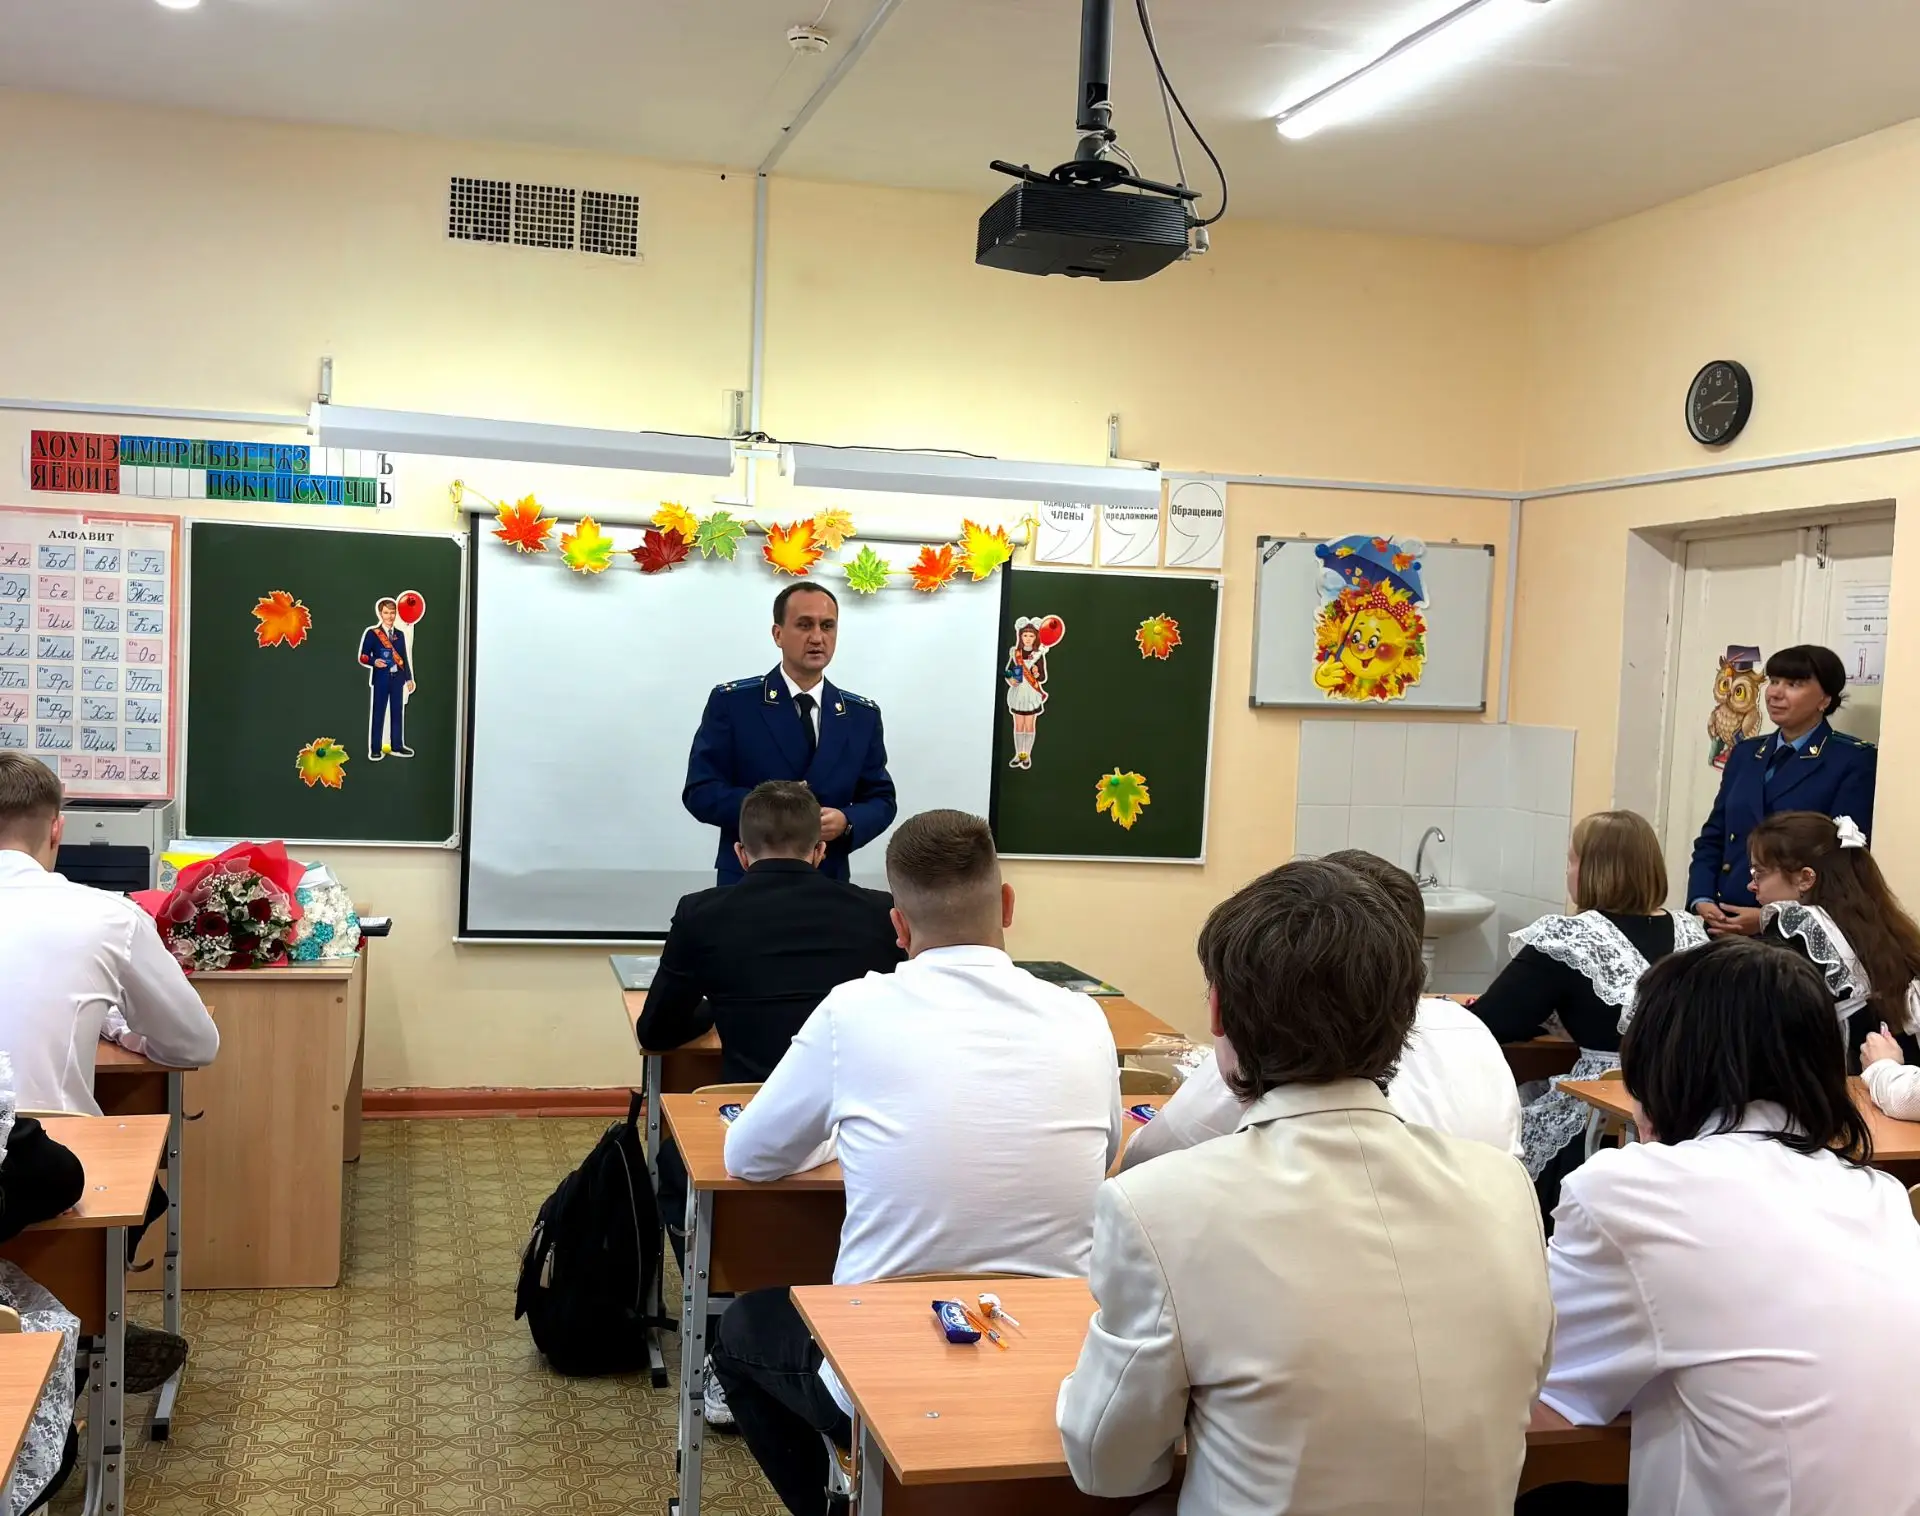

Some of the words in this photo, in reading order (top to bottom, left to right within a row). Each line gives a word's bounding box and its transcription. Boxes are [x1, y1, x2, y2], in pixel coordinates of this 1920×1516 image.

[1050, 510, 1084, 520] члены
[1106, 511, 1158, 521] предложение
[1171, 504, 1222, 518] Обращение
[48, 530, 114, 542] АЛФАВИТ
[2, 552, 29, 566] Аа
[45, 552, 75, 568] Бб
[95, 555, 118, 570] Вв
[140, 557, 161, 572] Гг
[2, 581, 27, 602] Дд
[50, 583, 68, 598] Ее
[128, 587, 164, 603] Жж
[48, 613, 72, 628] Ии
[134, 617, 161, 632] Кк
[38, 644, 73, 658] Мм
[91, 645, 118, 660] Нн
[139, 647, 156, 662] Оо
[0, 671, 26, 686] Пп
[47, 673, 72, 694] Рр
[95, 674, 113, 689] Сс
[126, 676, 161, 691] Тт
[47, 703, 71, 724] Фф
[90, 704, 115, 719] Хх
[135, 706, 158, 723] Цц
[38, 733, 72, 748] Шш
